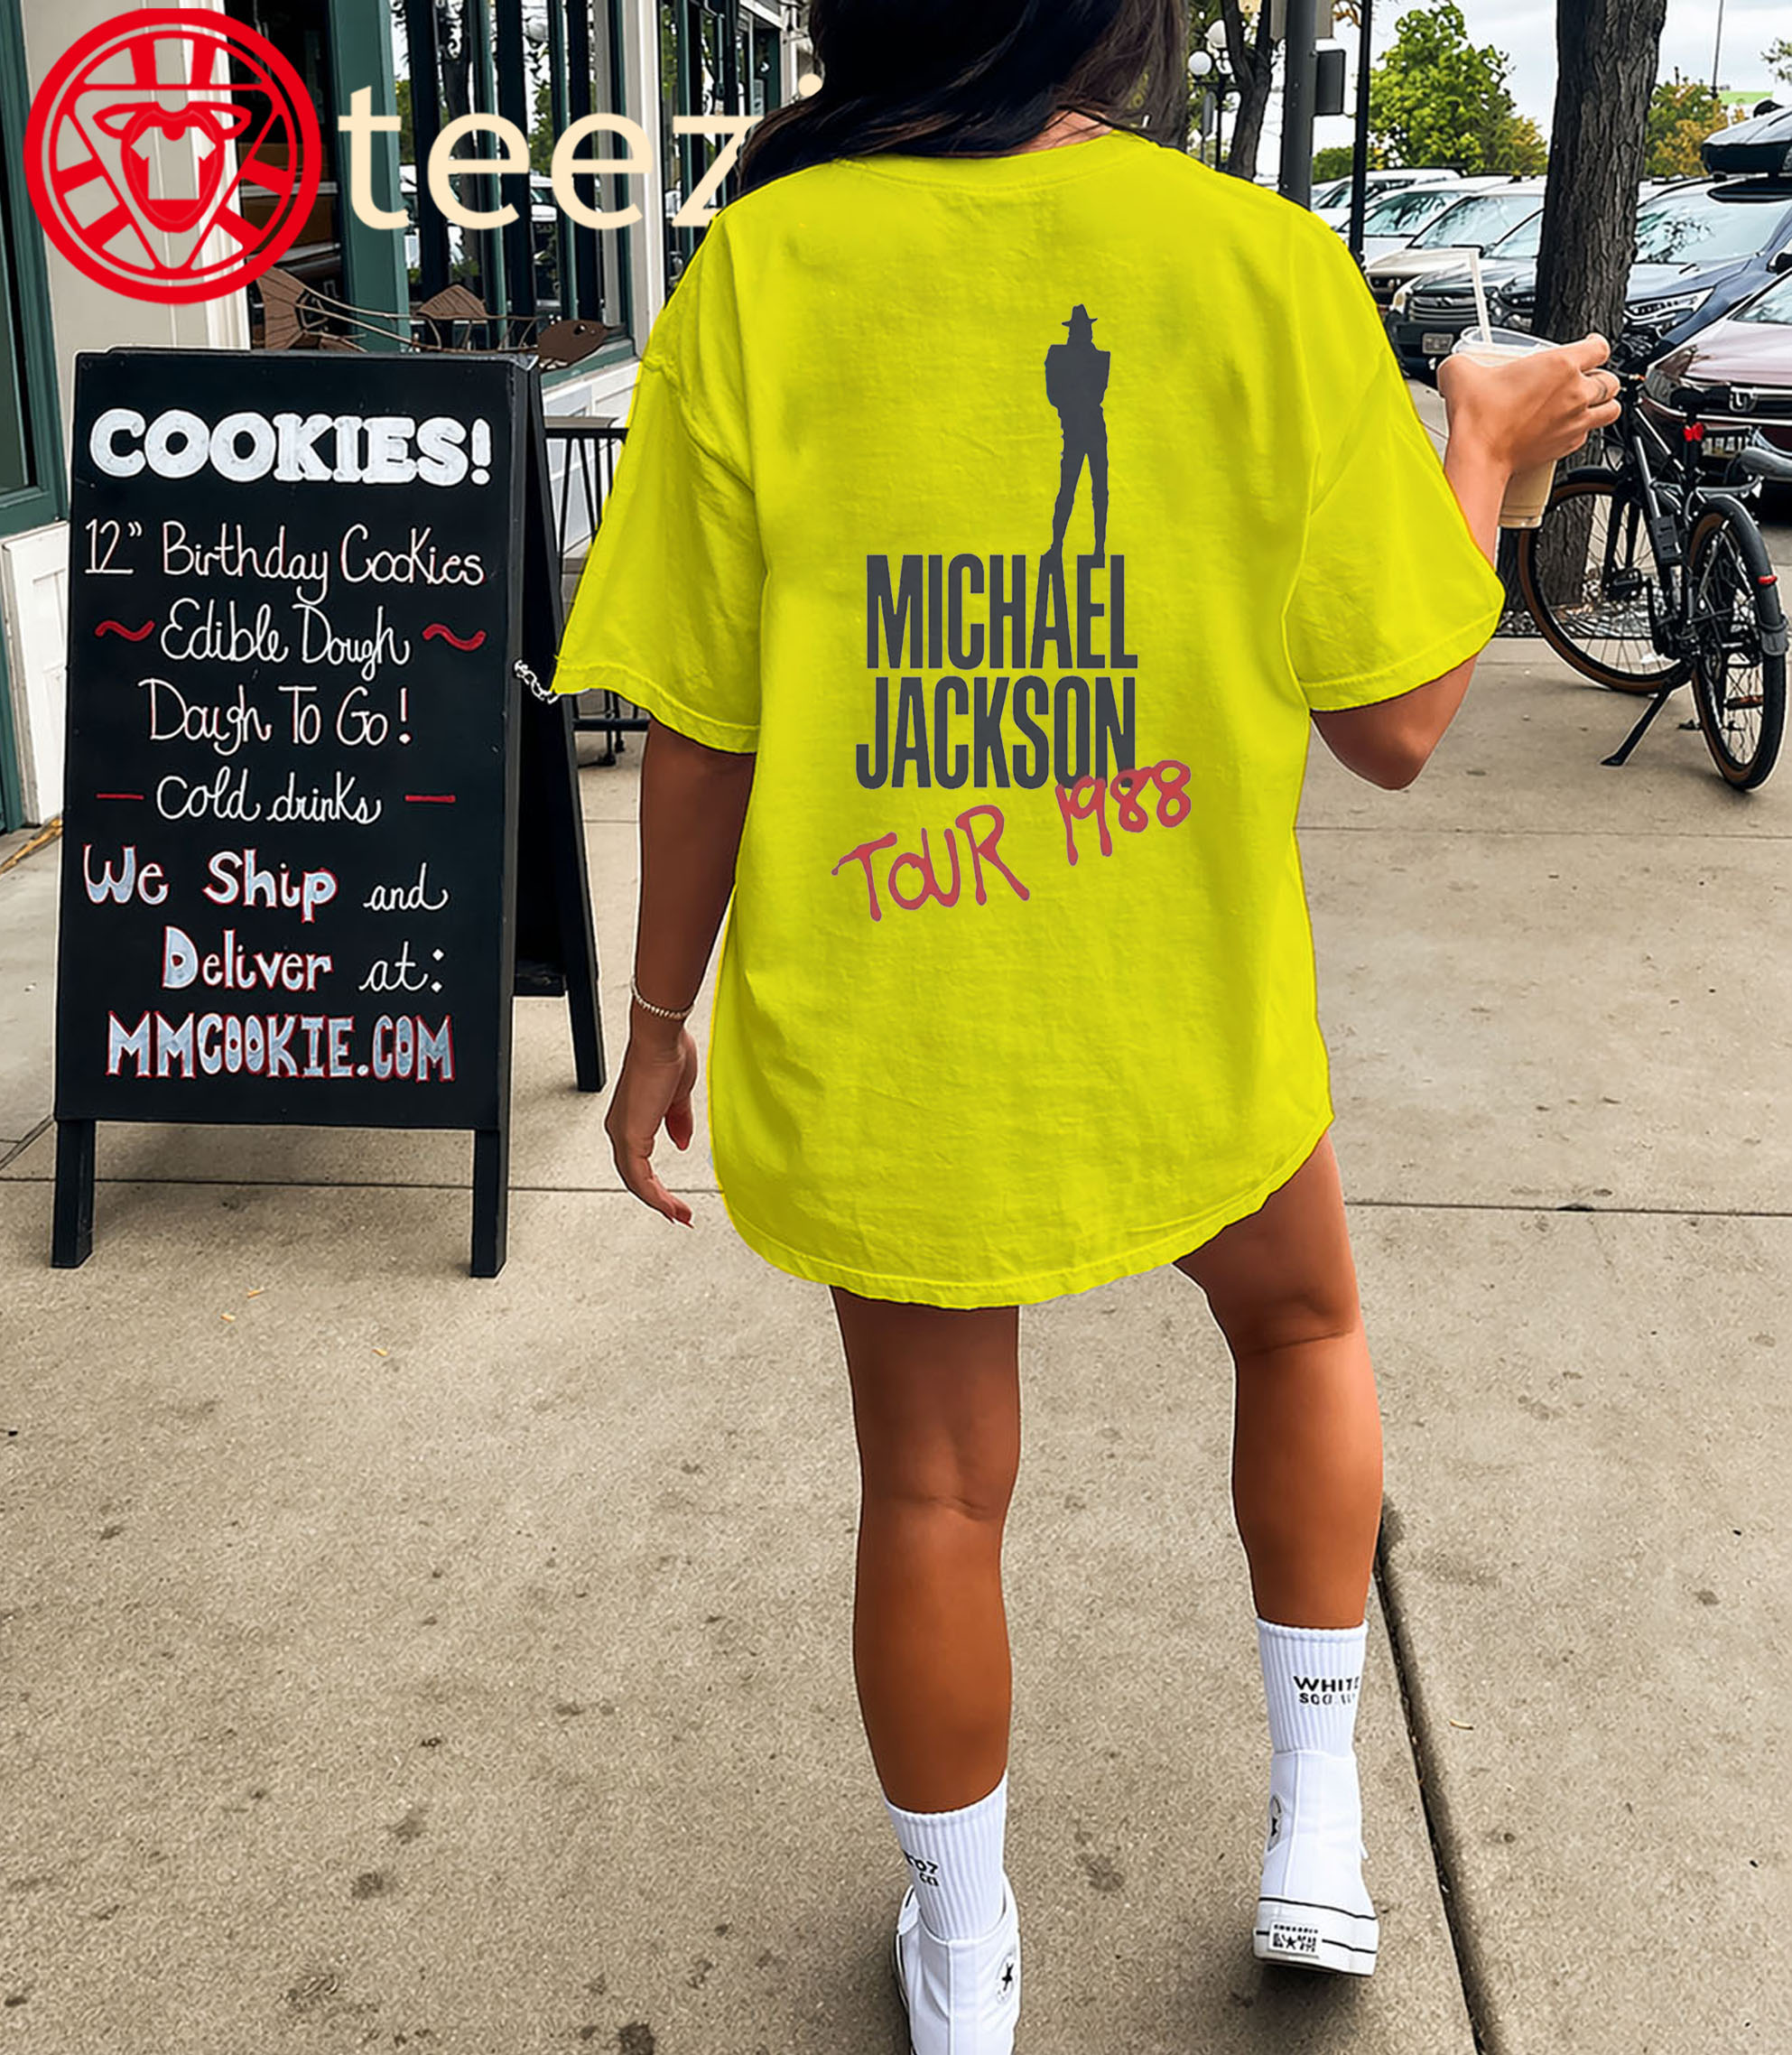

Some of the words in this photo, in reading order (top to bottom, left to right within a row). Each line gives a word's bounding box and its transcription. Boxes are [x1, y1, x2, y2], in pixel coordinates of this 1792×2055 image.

[89, 409, 491, 486] COOKIES!
[163, 521, 329, 604] Birthday
[161, 598, 289, 663] Edible
[292, 602, 410, 681] Dough
[867, 553, 1137, 670] MICHAEL
[856, 675, 1136, 789] JACKSON
[157, 766, 261, 821] Cold
[1055, 759, 1192, 866] 1988
[83, 844, 170, 905] We
[202, 848, 338, 924] Ship
[362, 862, 449, 911] and
[162, 925, 333, 991] Deliver
[358, 941, 444, 992] at:
[106, 1010, 455, 1083] MMCOOKIE.COM
